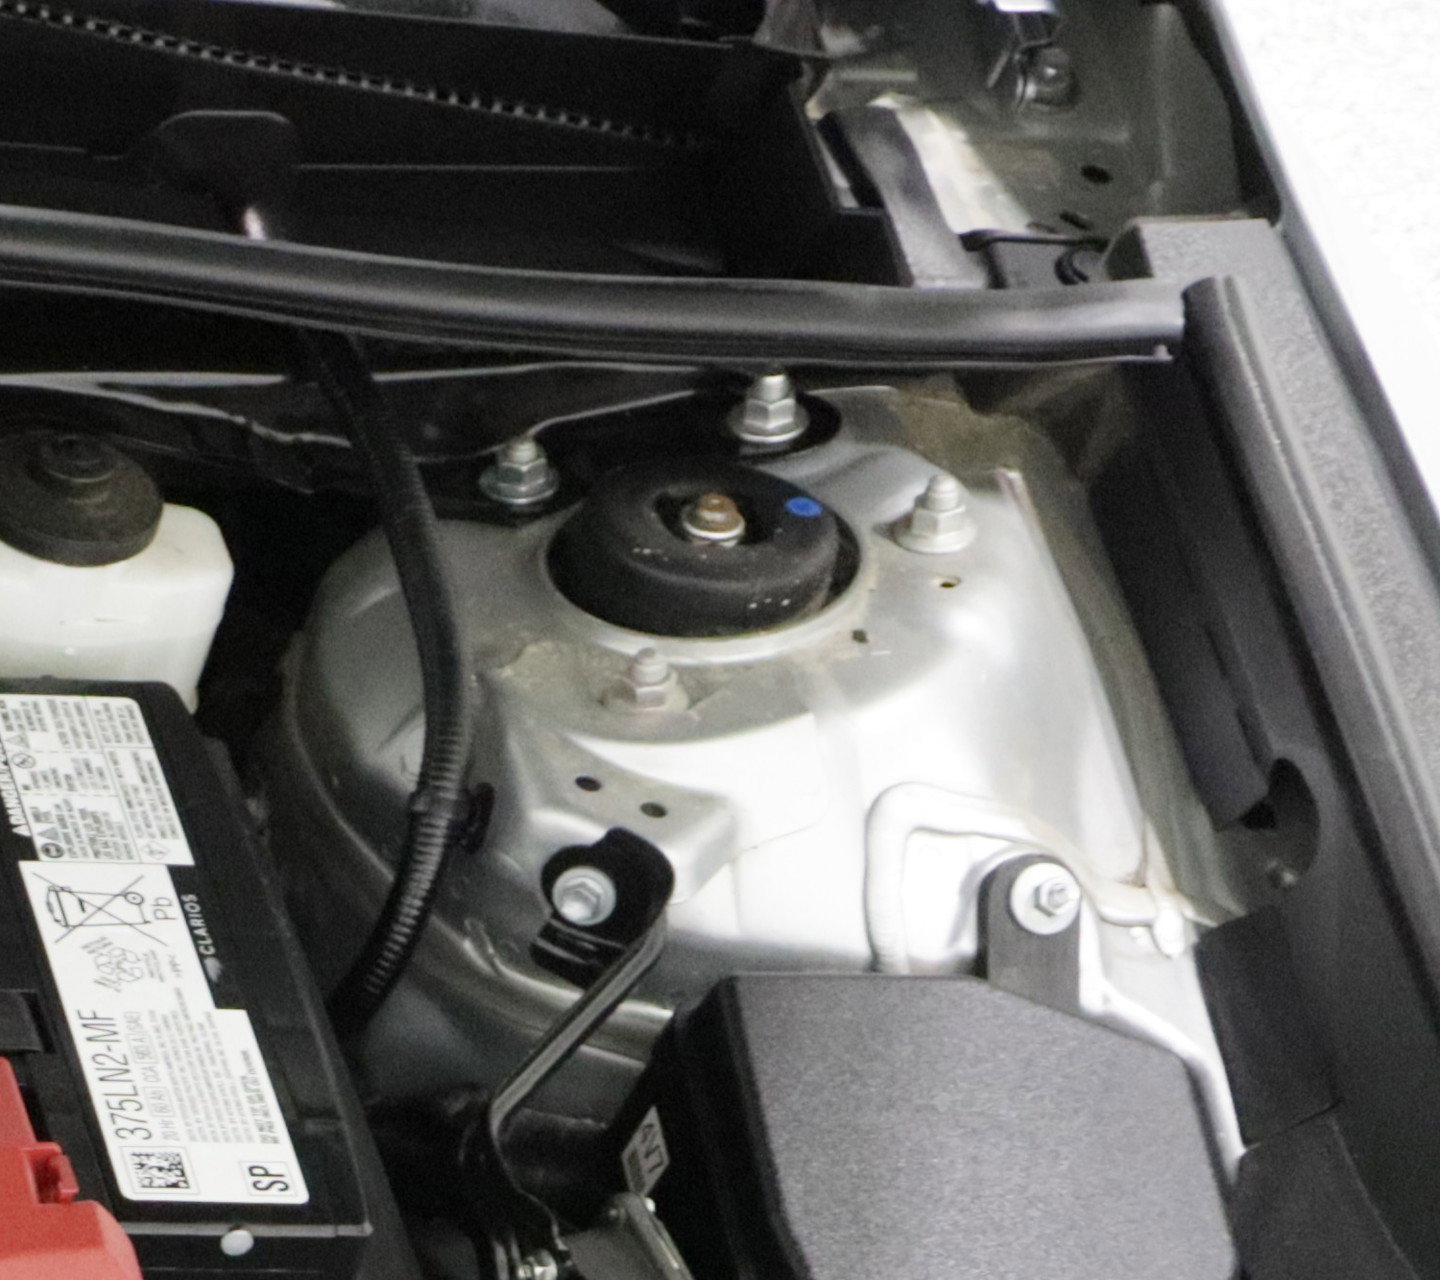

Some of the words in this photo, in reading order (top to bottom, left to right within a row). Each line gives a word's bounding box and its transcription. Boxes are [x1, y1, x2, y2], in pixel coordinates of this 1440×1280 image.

[151, 897, 175, 920] Pb
[181, 893, 215, 955] CLARIOS
[76, 1009, 153, 1140] 375LN2-MF
[248, 1165, 289, 1191] SP
